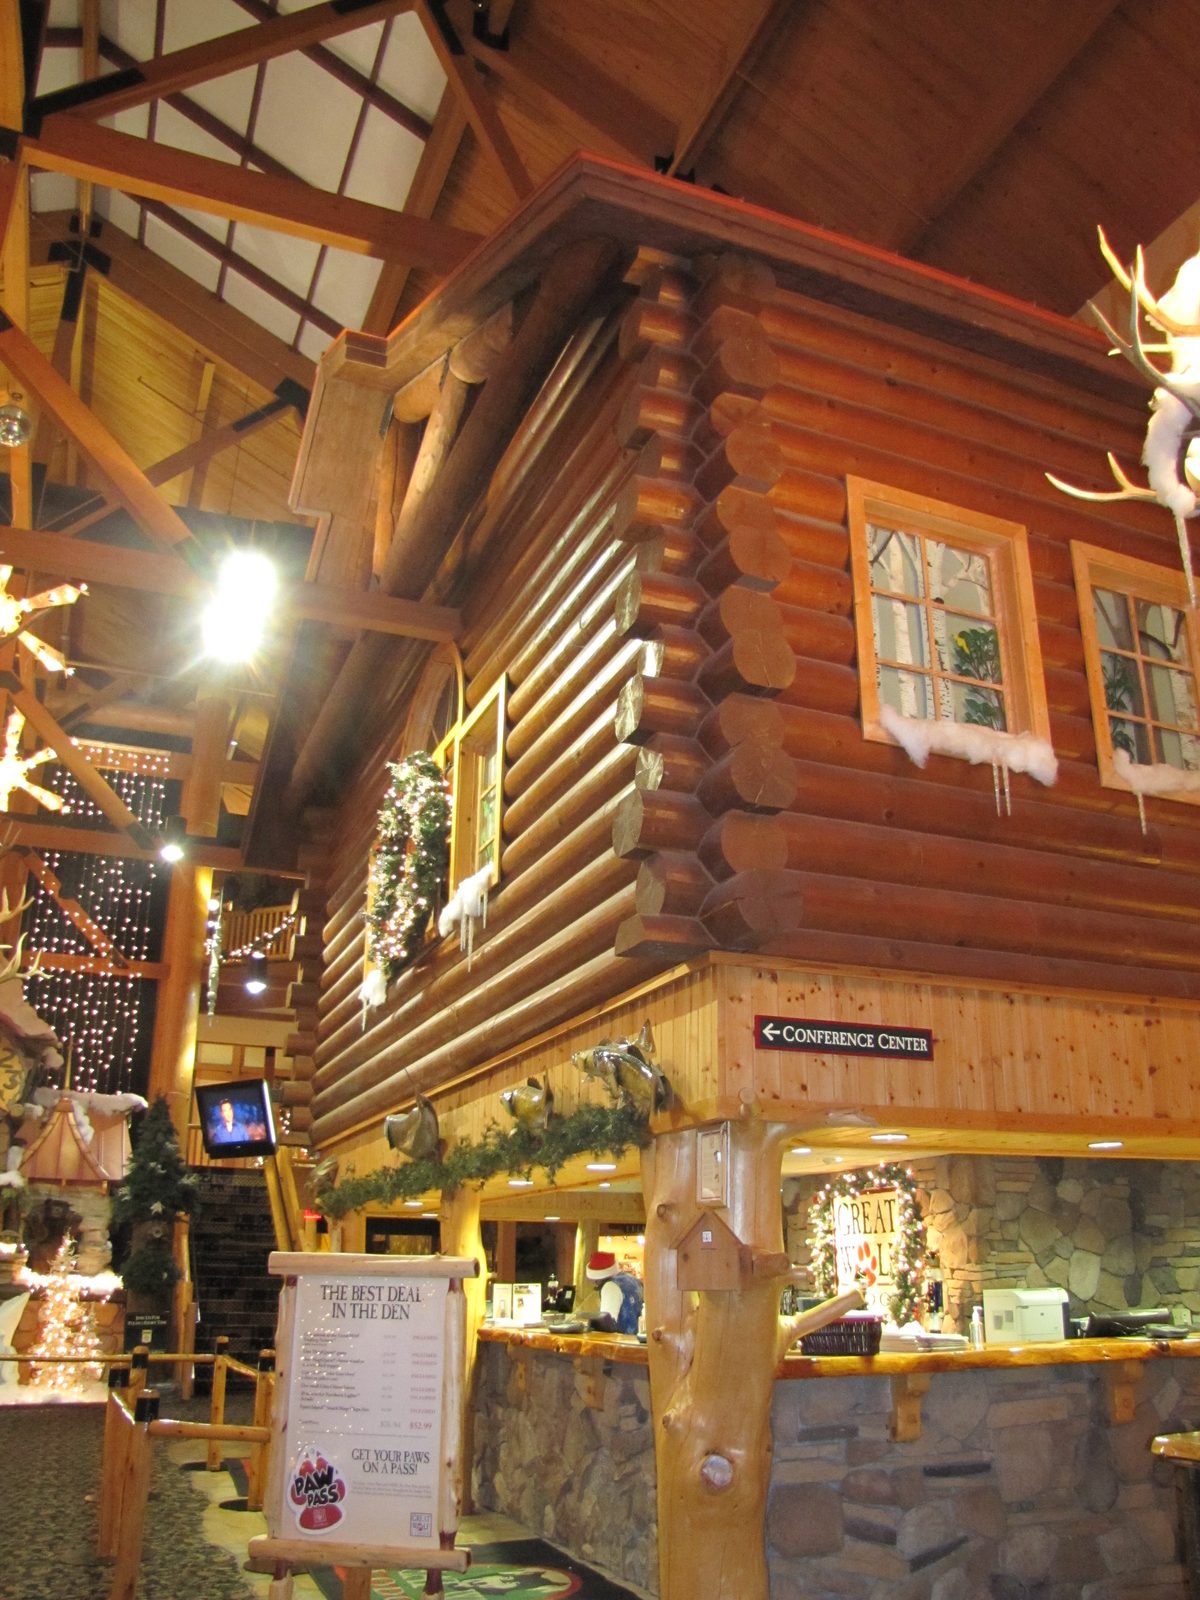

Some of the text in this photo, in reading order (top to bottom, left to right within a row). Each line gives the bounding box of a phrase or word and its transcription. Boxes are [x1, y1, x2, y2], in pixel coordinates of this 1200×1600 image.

[783, 1026, 928, 1052] CONFERENCE CENTER
[3, 1070, 19, 1089] 3
[838, 1199, 896, 1236] GREAT
[320, 1285, 422, 1303] THE BEST DEAL
[332, 1303, 410, 1320] IN THE DEN
[351, 1448, 430, 1464] GET YOUR PAWS
[362, 1461, 418, 1475] ON A PASS!
[294, 1465, 334, 1496] PAW
[307, 1484, 339, 1507] PASS
